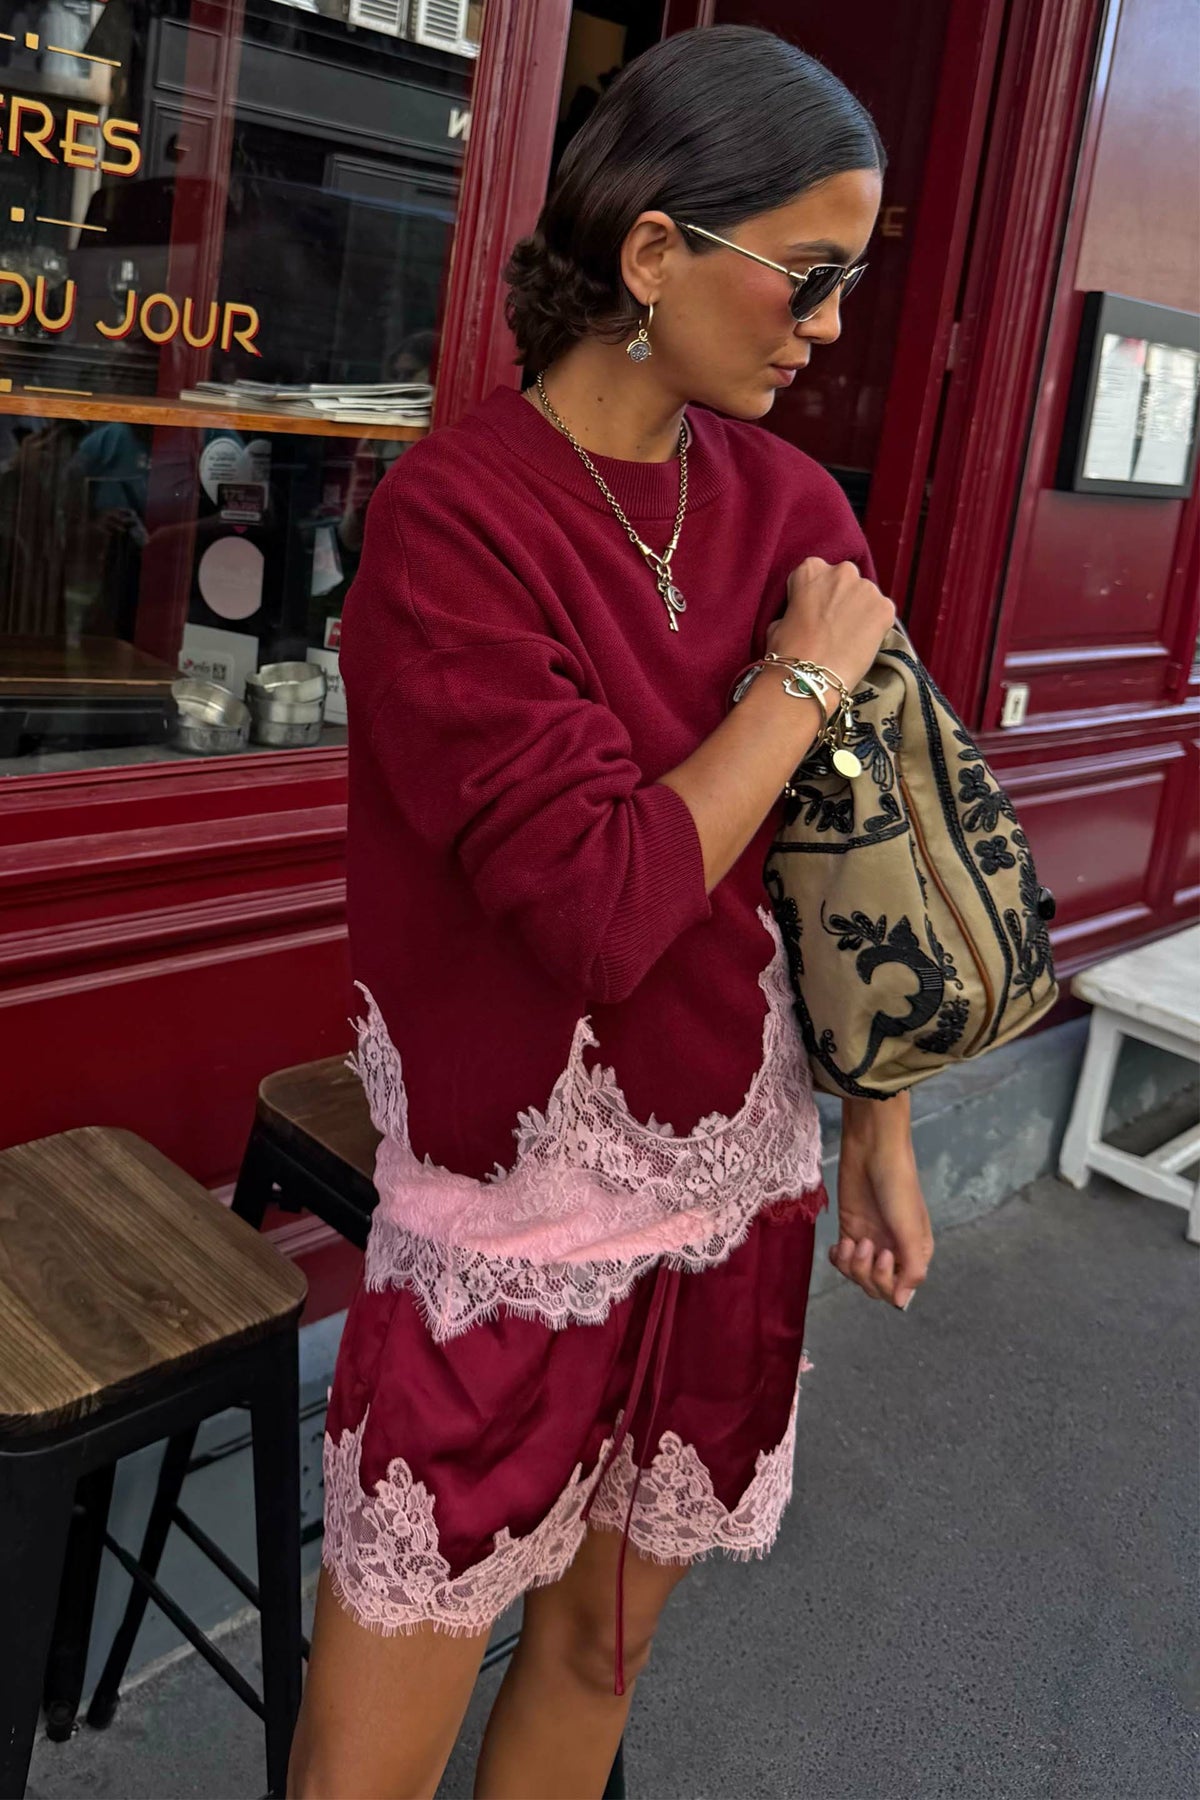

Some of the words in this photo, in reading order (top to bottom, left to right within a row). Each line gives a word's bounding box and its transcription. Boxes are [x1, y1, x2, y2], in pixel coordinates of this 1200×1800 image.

[0, 93, 142, 178] RES
[880, 206, 906, 236] E
[0, 270, 77, 333] DU
[96, 289, 262, 357] JOUR
